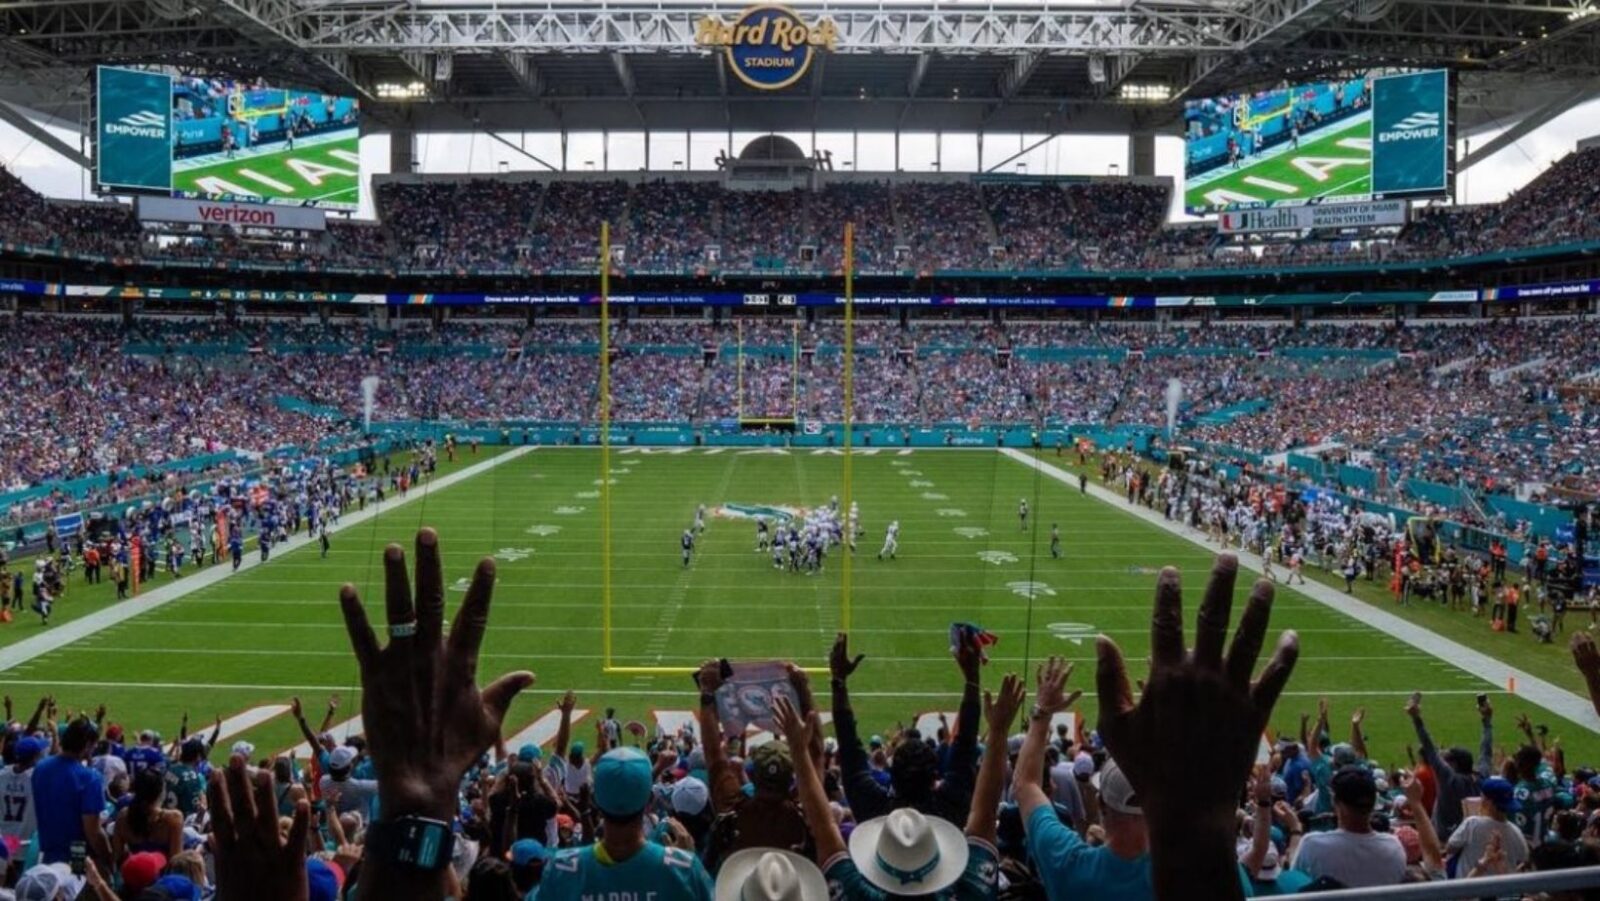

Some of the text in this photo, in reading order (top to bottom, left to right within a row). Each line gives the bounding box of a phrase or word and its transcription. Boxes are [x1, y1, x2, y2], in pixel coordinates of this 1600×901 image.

[695, 15, 837, 52] Hard Rock
[744, 57, 795, 68] STADIUM
[105, 123, 166, 140] EMPOWER
[1378, 127, 1439, 143] EMPOWER
[198, 205, 275, 226] verizon
[1312, 201, 1400, 216] UNIVERSITY OF MIAMI
[1312, 213, 1376, 226] HEALTH SYSTEM
[3, 795, 28, 822] 17
